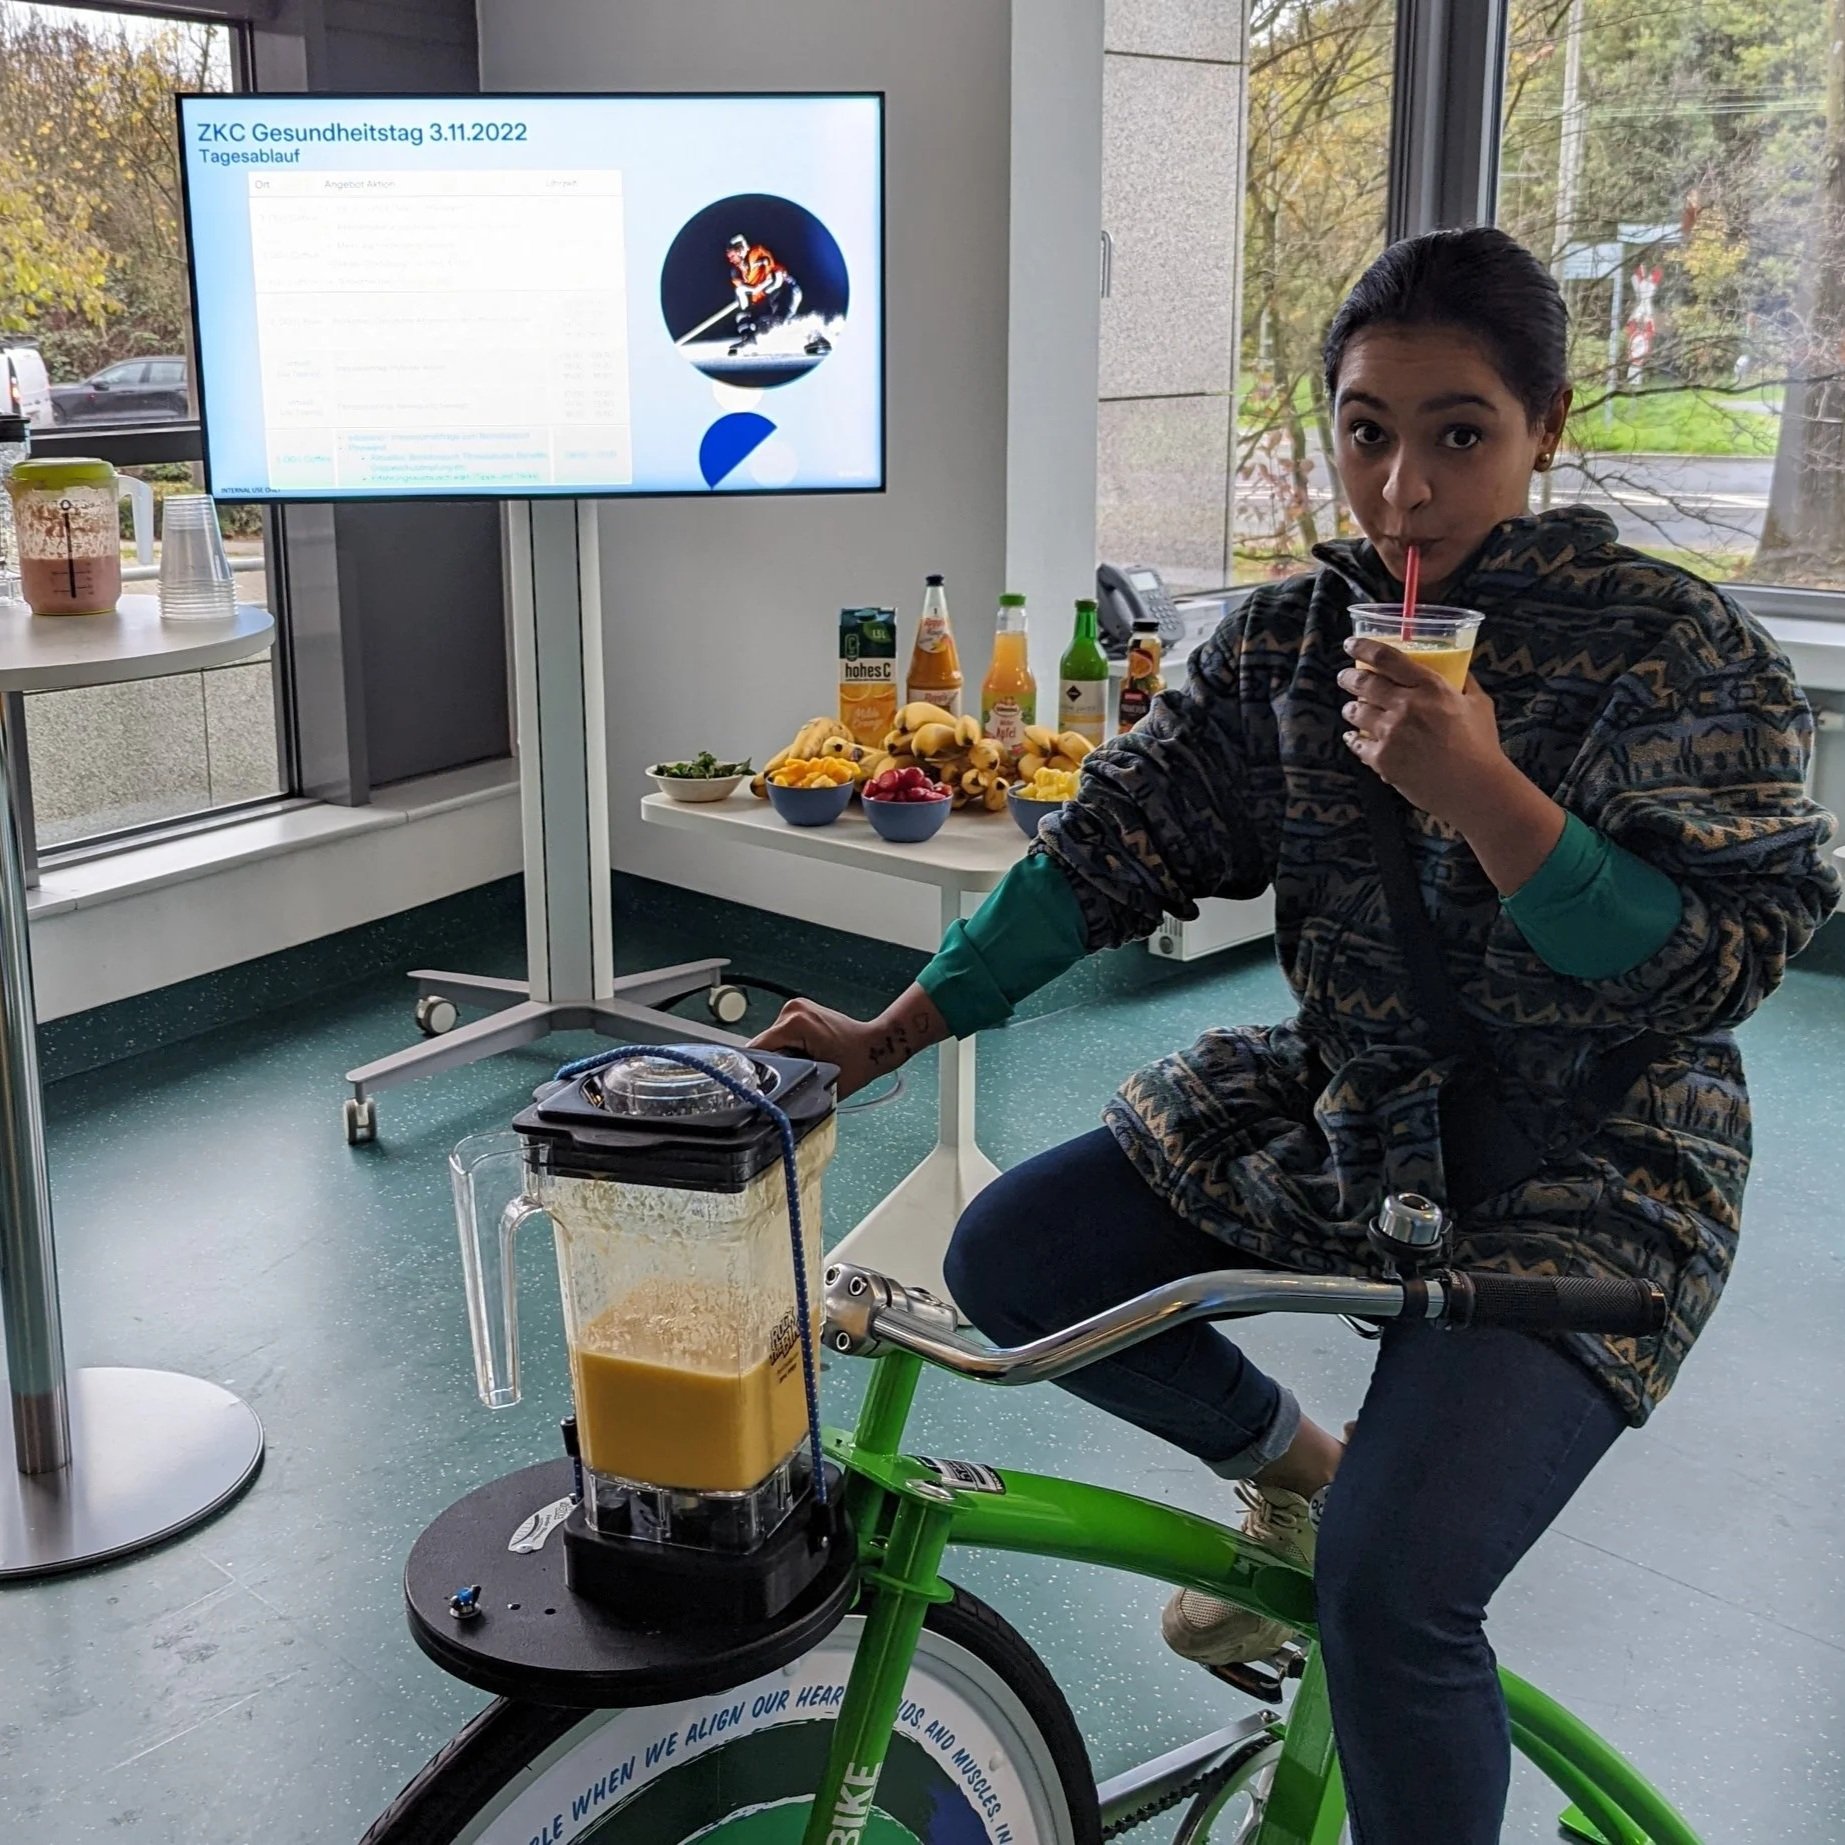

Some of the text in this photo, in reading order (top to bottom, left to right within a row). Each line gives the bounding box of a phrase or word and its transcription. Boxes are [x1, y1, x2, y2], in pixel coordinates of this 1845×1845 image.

[198, 122, 528, 146] ZKC Gesundheitstag 3.11.2022
[200, 148, 301, 166] Tagesablauf
[254, 179, 271, 190] Ort
[324, 179, 364, 192] Angebot
[845, 662, 891, 678] hohes C
[572, 1756, 635, 1821] WHEN
[645, 1732, 679, 1768] WE
[685, 1702, 746, 1746] ALIGN
[752, 1690, 790, 1718] OUR
[796, 1685, 845, 1708] HEAR
[924, 1720, 956, 1750] AND
[826, 1762, 883, 1845] BIKE
